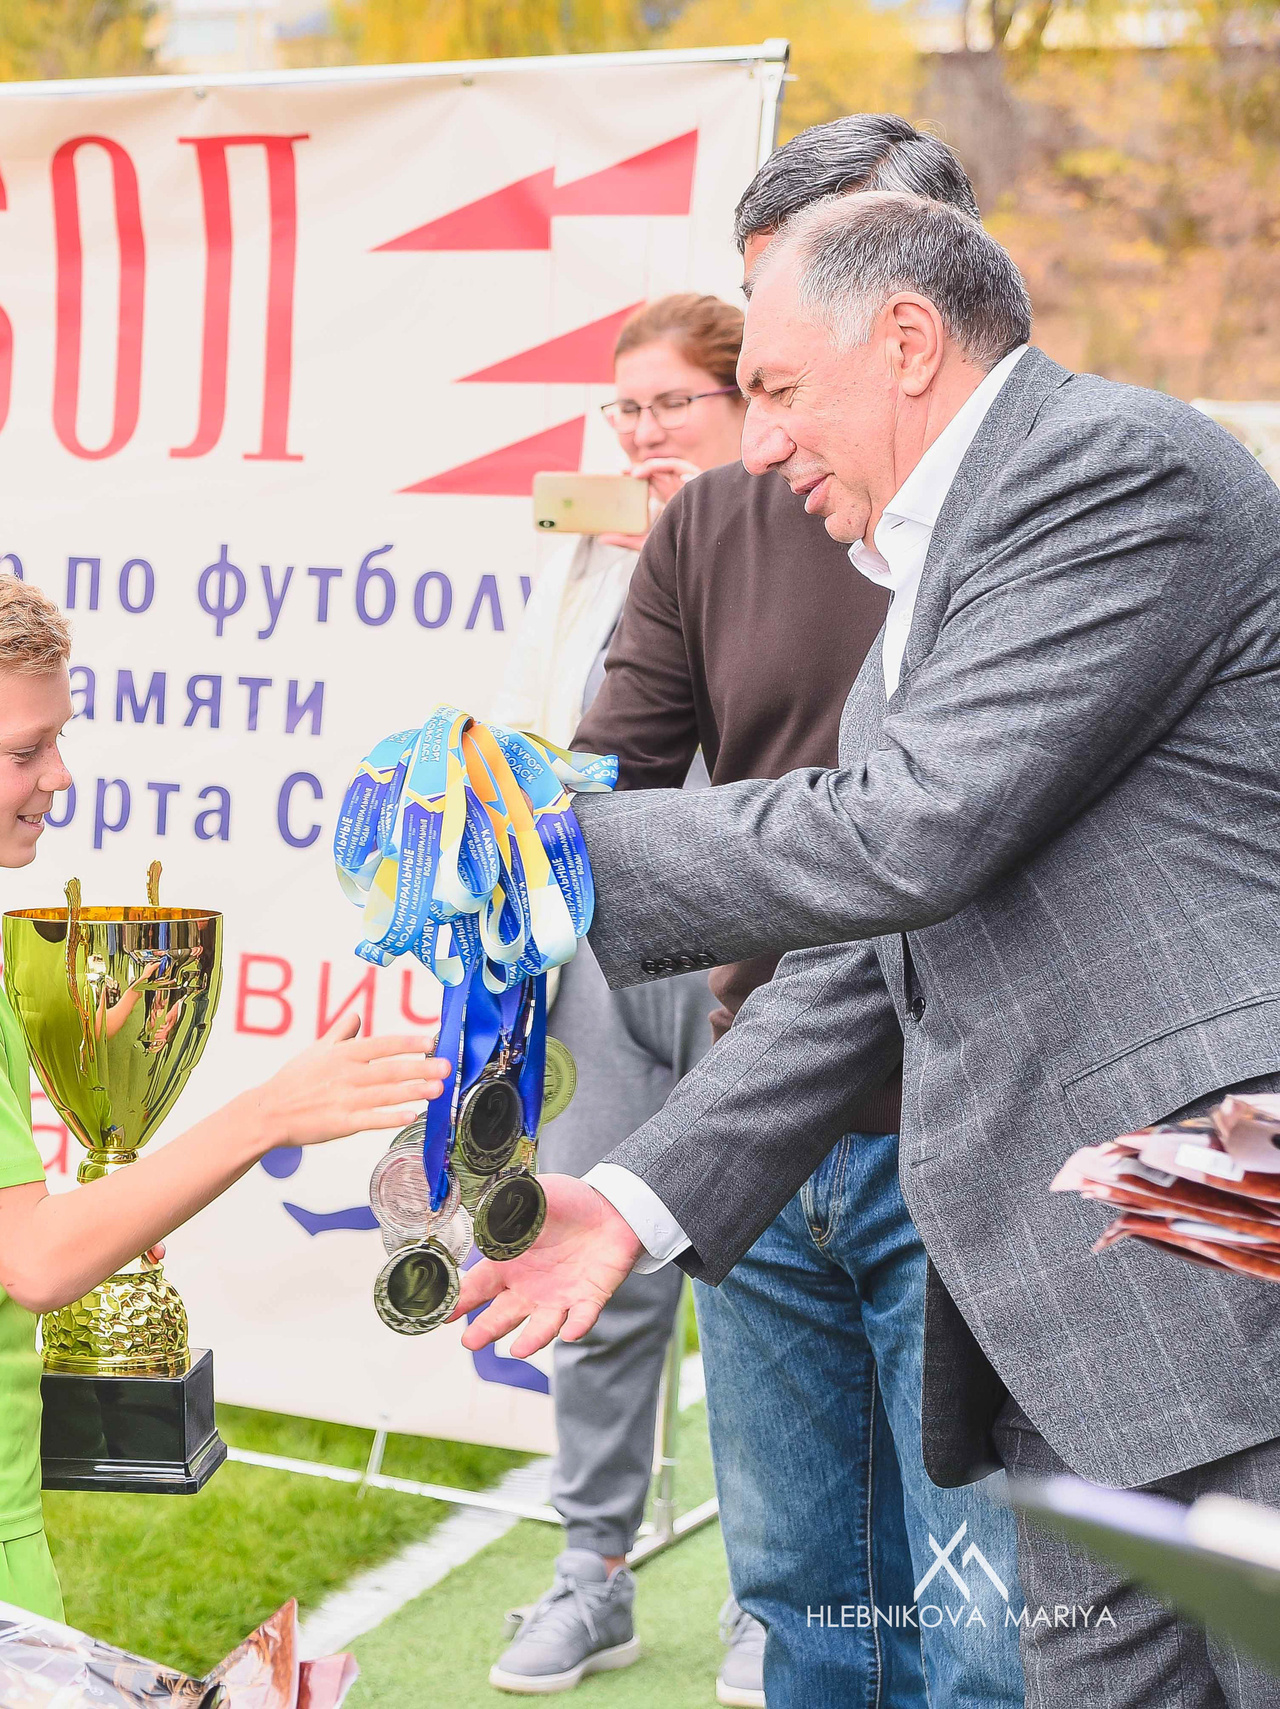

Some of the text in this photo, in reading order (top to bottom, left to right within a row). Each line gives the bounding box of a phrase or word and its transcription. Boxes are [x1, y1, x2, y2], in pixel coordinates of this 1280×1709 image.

[65, 554, 156, 614] по
[70, 664, 326, 736] амяти
[45, 776, 232, 852] орта
[393, 848, 416, 933] МИНЕРАЛЬНЫЕ
[394, 913, 419, 949] ВОДЫ
